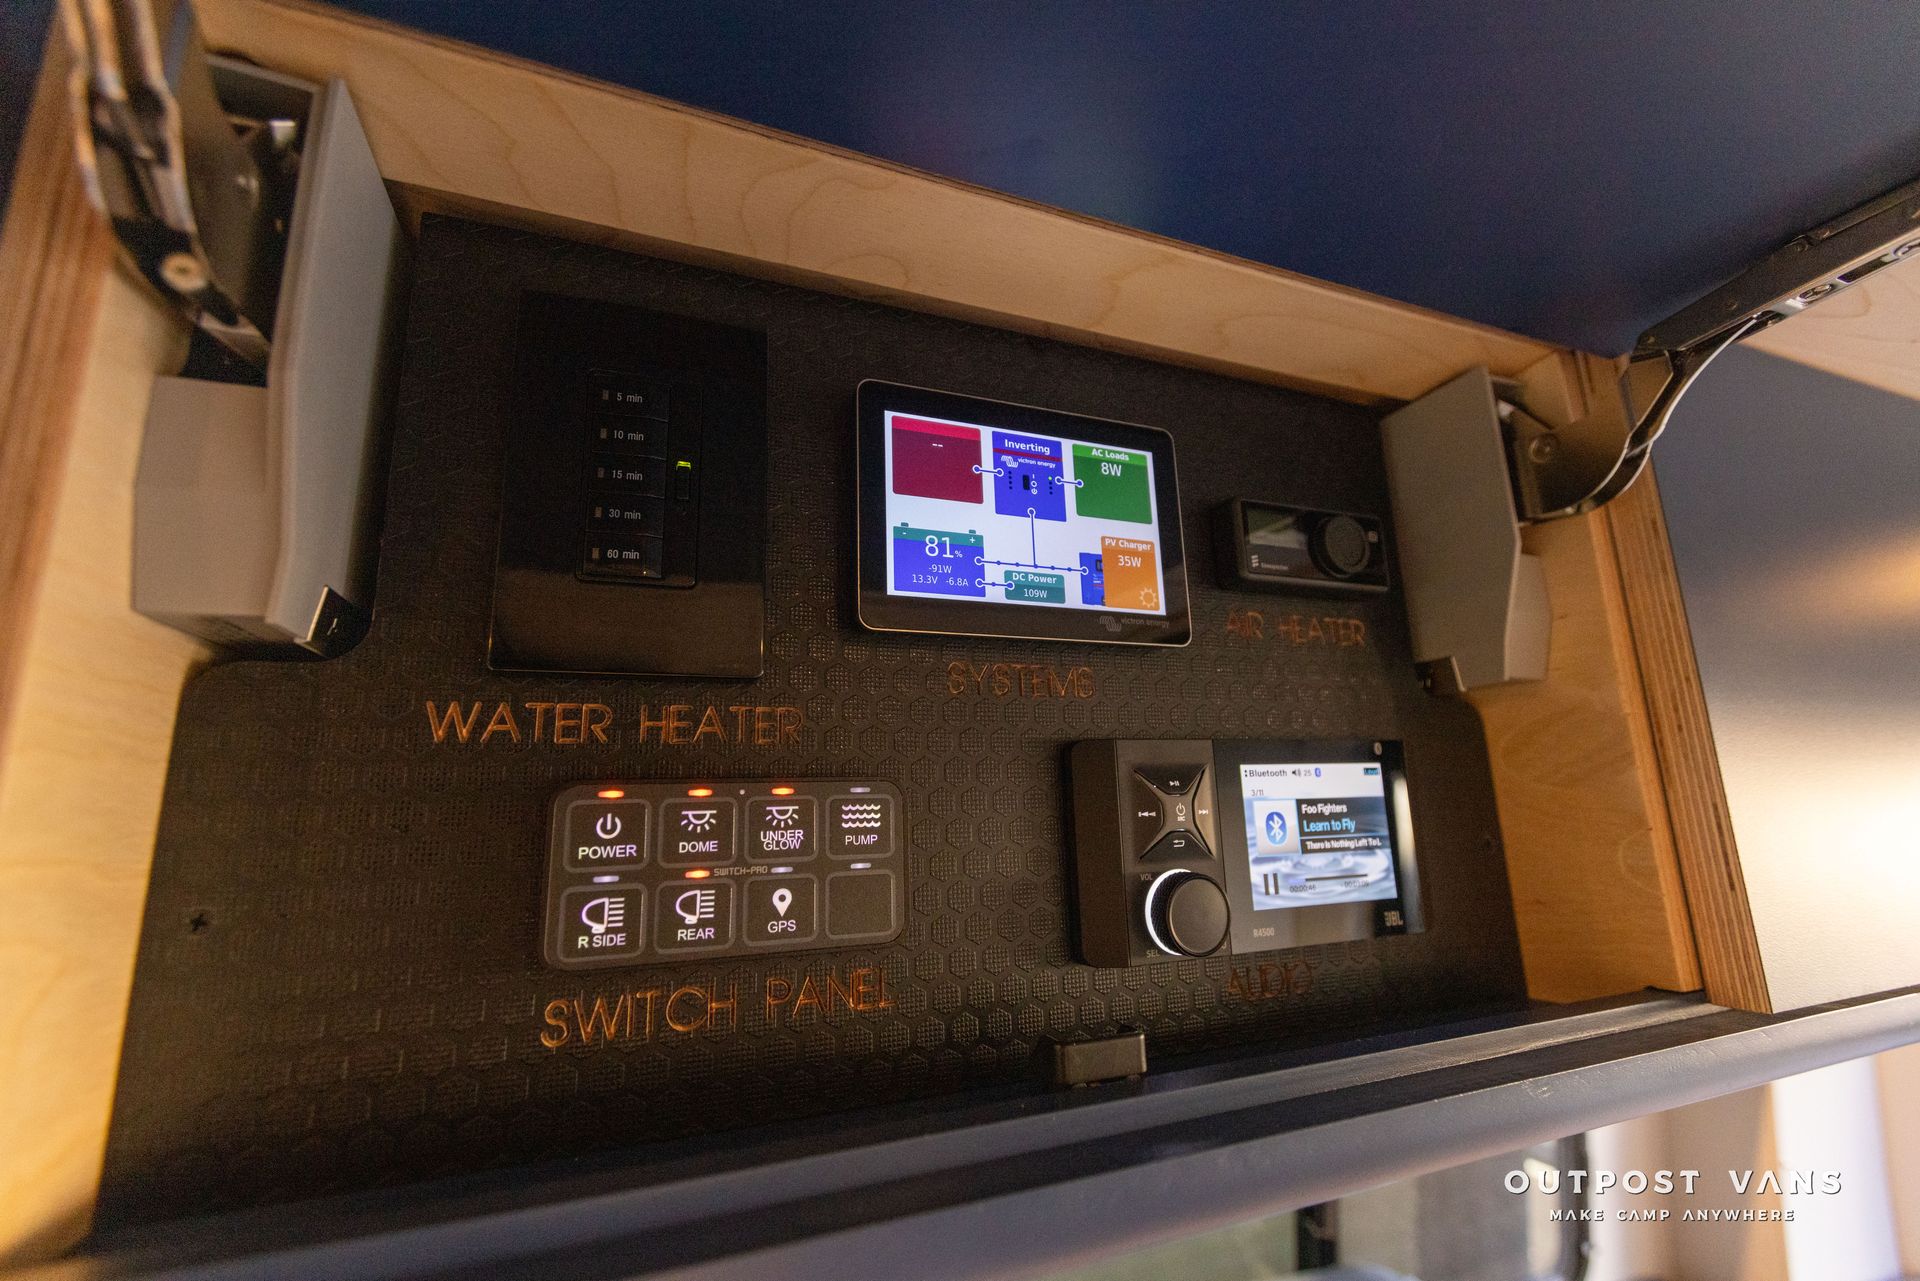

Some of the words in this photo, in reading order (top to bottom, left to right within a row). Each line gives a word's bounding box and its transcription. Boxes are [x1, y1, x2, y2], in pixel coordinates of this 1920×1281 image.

[616, 392, 623, 402] 5
[626, 393, 643, 404] min
[613, 429, 624, 440] 10
[627, 431, 644, 442] min
[1004, 439, 1051, 456] Inverting
[1091, 448, 1104, 457] AC
[1105, 449, 1130, 462] Loads
[1017, 457, 1037, 466] victron
[1037, 460, 1056, 469] energy
[1100, 462, 1122, 478] 8W
[611, 469, 623, 480] 15
[626, 470, 643, 481] min
[608, 508, 620, 519] 30
[624, 509, 641, 520] min
[1105, 537, 1117, 547] PV
[1118, 539, 1152, 552] Charger
[607, 549, 619, 559] 60
[622, 550, 640, 560] min
[928, 563, 952, 574] -91W
[1117, 555, 1143, 569] 35W
[912, 573, 938, 585] 13.3V
[945, 576, 969, 588] -6.8A
[1012, 572, 1026, 582] DC
[1028, 573, 1057, 584] Power
[1023, 588, 1048, 599] 109W
[1278, 615, 1366, 648] HEATER
[947, 661, 1095, 699] SYSTEMS
[425, 700, 614, 745] WATER
[639, 704, 804, 746] HEATER
[1249, 768, 1288, 778] Bluetooth
[1301, 804, 1317, 815] Foo
[1317, 802, 1348, 816] Fighters
[1303, 819, 1330, 833] Learn
[1330, 818, 1341, 831] to
[1341, 817, 1356, 833] Fly
[760, 829, 804, 842] UNDER
[845, 834, 878, 846] PUMP
[678, 840, 719, 854] DOME
[763, 839, 801, 851] GLOW
[1305, 840, 1325, 850] There
[1330, 838, 1355, 849] Nothing
[1355, 837, 1368, 848] Left
[578, 844, 637, 860] POWER
[713, 865, 769, 877] SWITCH-PRO
[1140, 873, 1154, 882] VOL
[1384, 909, 1404, 927] JBL
[767, 919, 797, 933] GPS
[577, 935, 589, 949] R
[592, 933, 627, 948] SIDE
[677, 927, 715, 941] REAR
[1146, 949, 1160, 959] SEL
[1226, 961, 1313, 1002] AUDIO
[540, 980, 738, 1049] SWITCH
[766, 967, 897, 1020] PANEL
